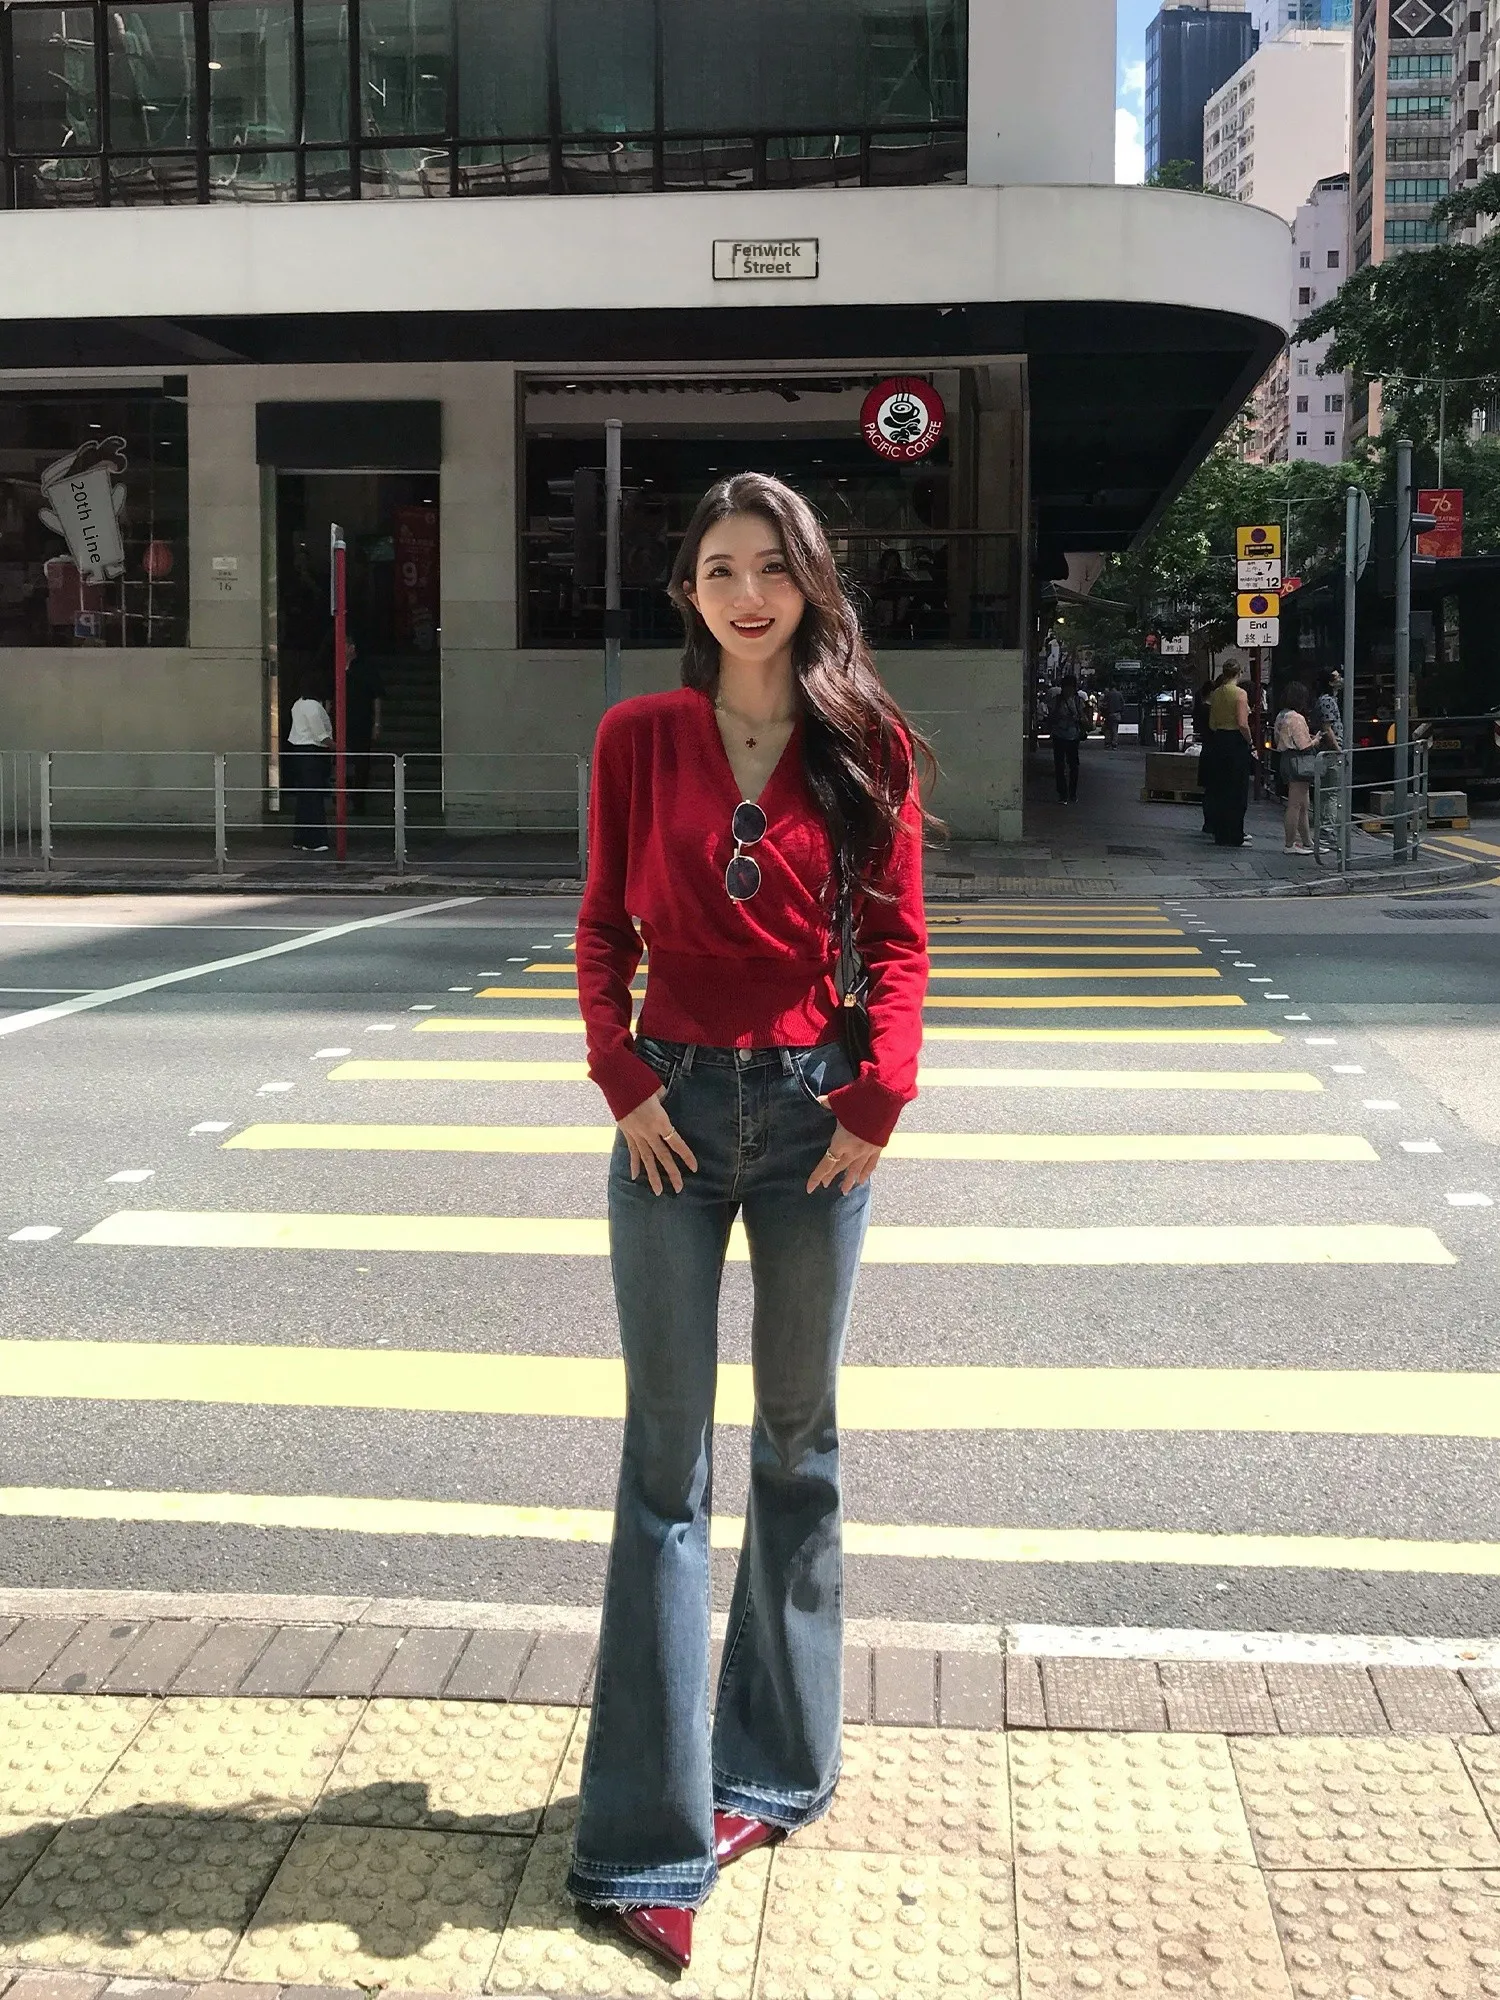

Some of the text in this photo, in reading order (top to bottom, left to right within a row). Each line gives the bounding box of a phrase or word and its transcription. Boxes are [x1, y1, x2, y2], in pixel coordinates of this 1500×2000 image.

[734, 243, 801, 257] Fenwick
[743, 261, 792, 273] Street
[864, 420, 941, 457] PACIFIC COFFEE
[1429, 493, 1452, 515] 76
[71, 481, 101, 564] 20th Line
[1265, 561, 1273, 571] 7
[219, 582, 231, 590] 16
[1266, 577, 1279, 587] 12
[1249, 621, 1268, 630] End
[1244, 633, 1272, 643] 終止
